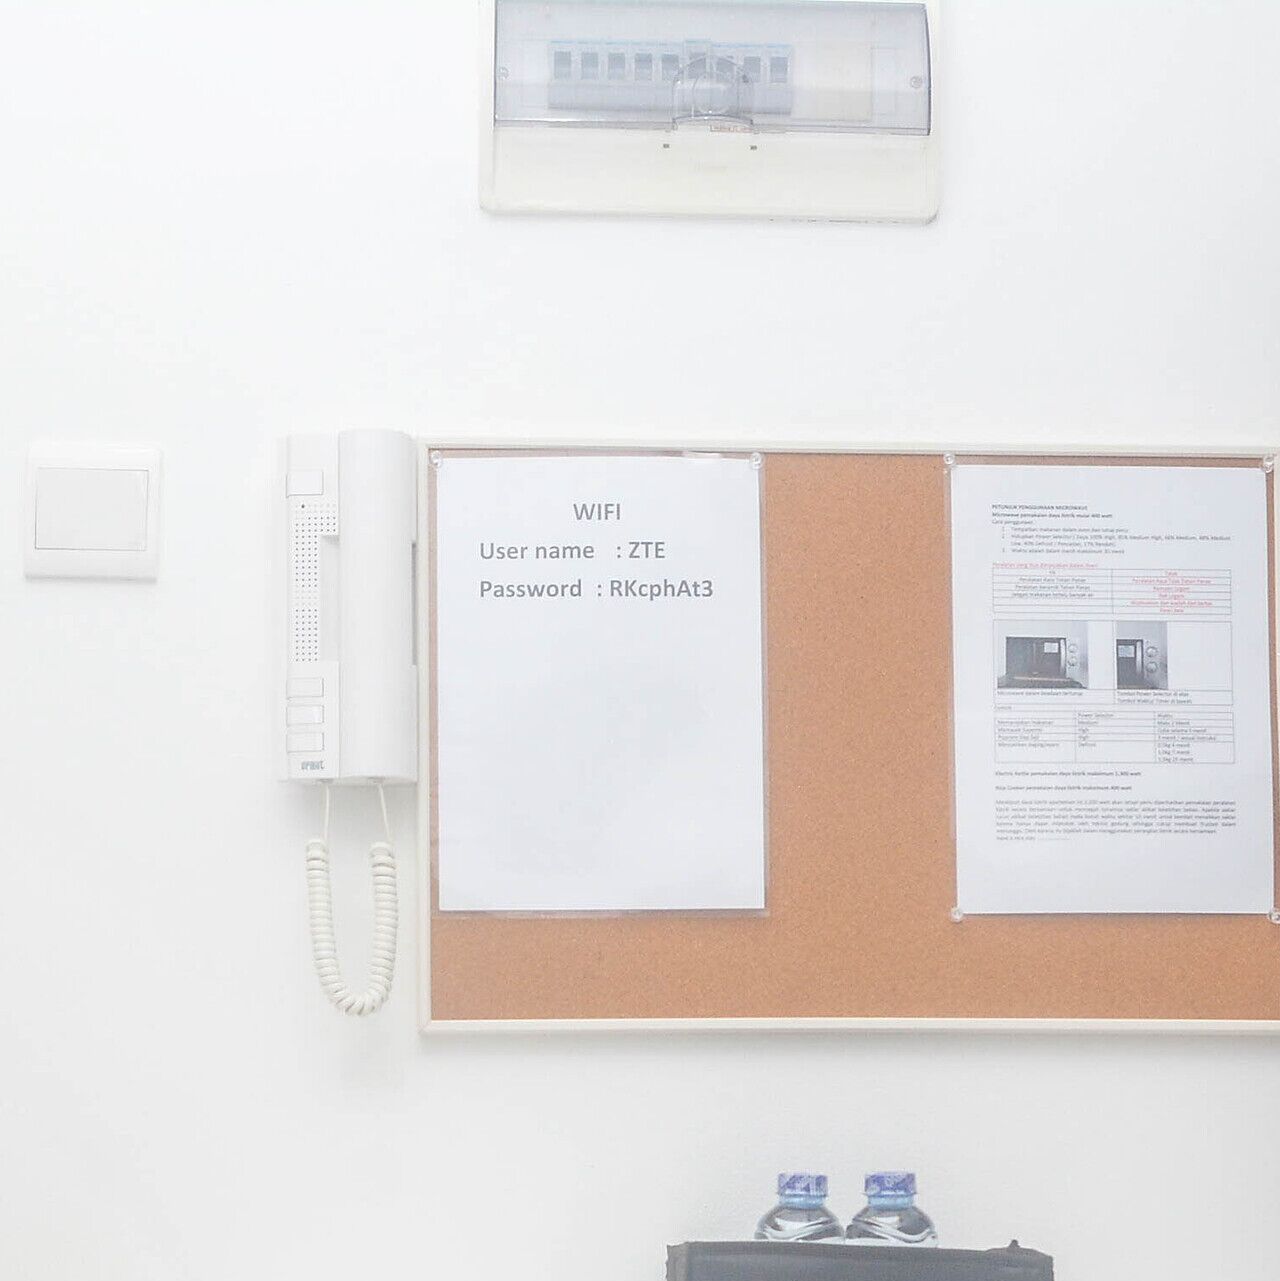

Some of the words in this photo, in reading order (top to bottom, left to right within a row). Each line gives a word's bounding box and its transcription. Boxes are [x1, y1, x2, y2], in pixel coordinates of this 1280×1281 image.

[573, 503, 621, 521] WIFI
[480, 542, 528, 560] User
[535, 545, 595, 559] name
[628, 541, 666, 559] ZTE
[480, 579, 582, 598] Password
[610, 579, 714, 602] RKcphAt3
